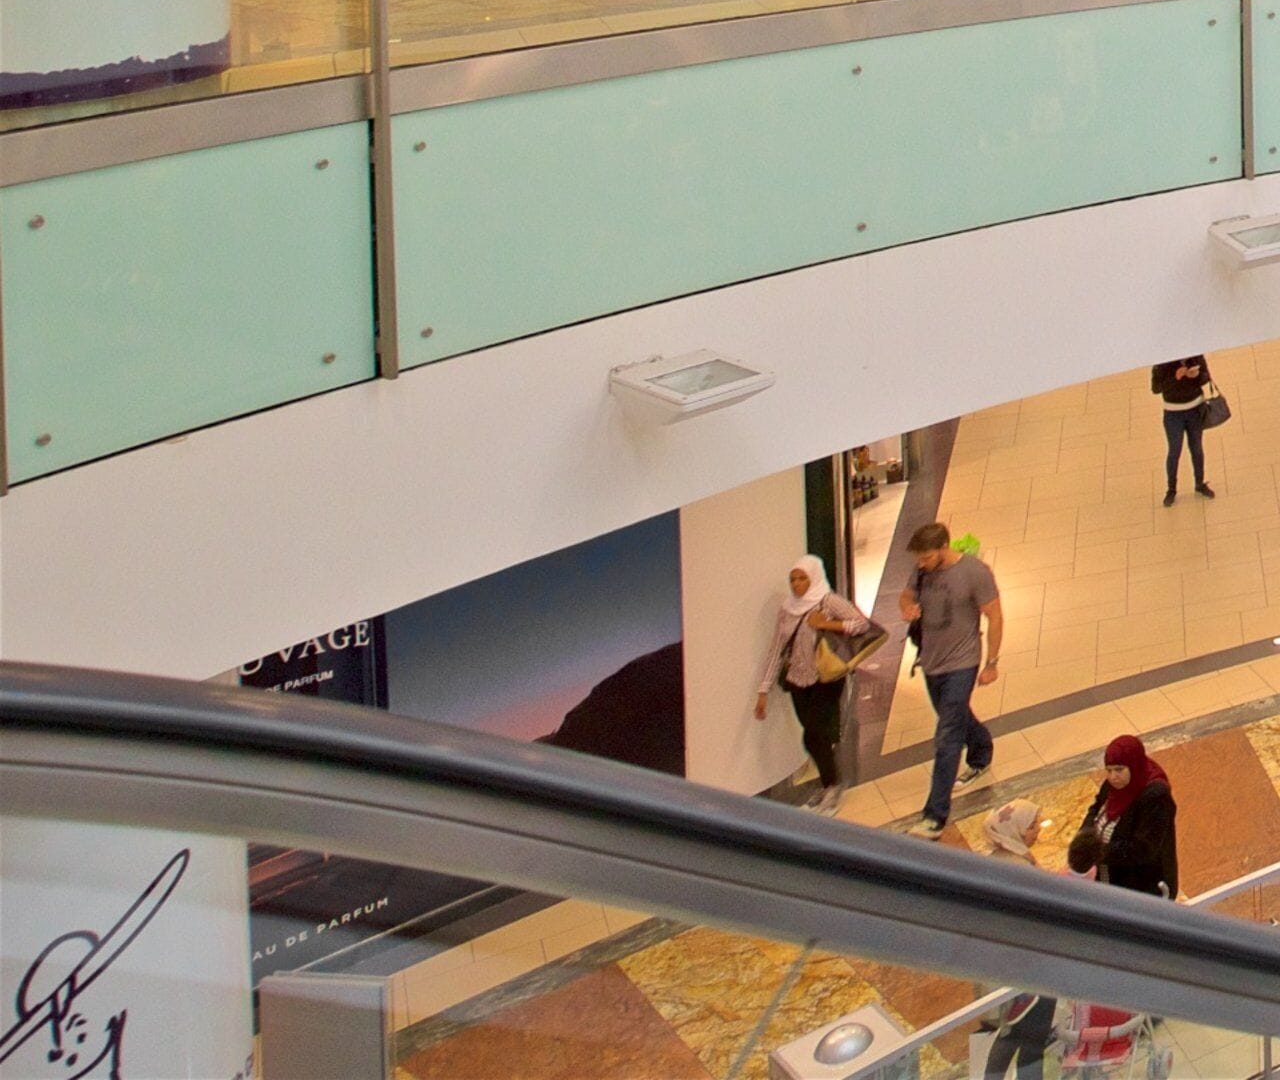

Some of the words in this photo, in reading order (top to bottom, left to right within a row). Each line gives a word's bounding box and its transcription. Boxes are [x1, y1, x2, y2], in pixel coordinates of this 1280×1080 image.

[284, 670, 334, 690] PARFUM
[285, 930, 308, 949] DE
[316, 897, 389, 934] PARFUM
